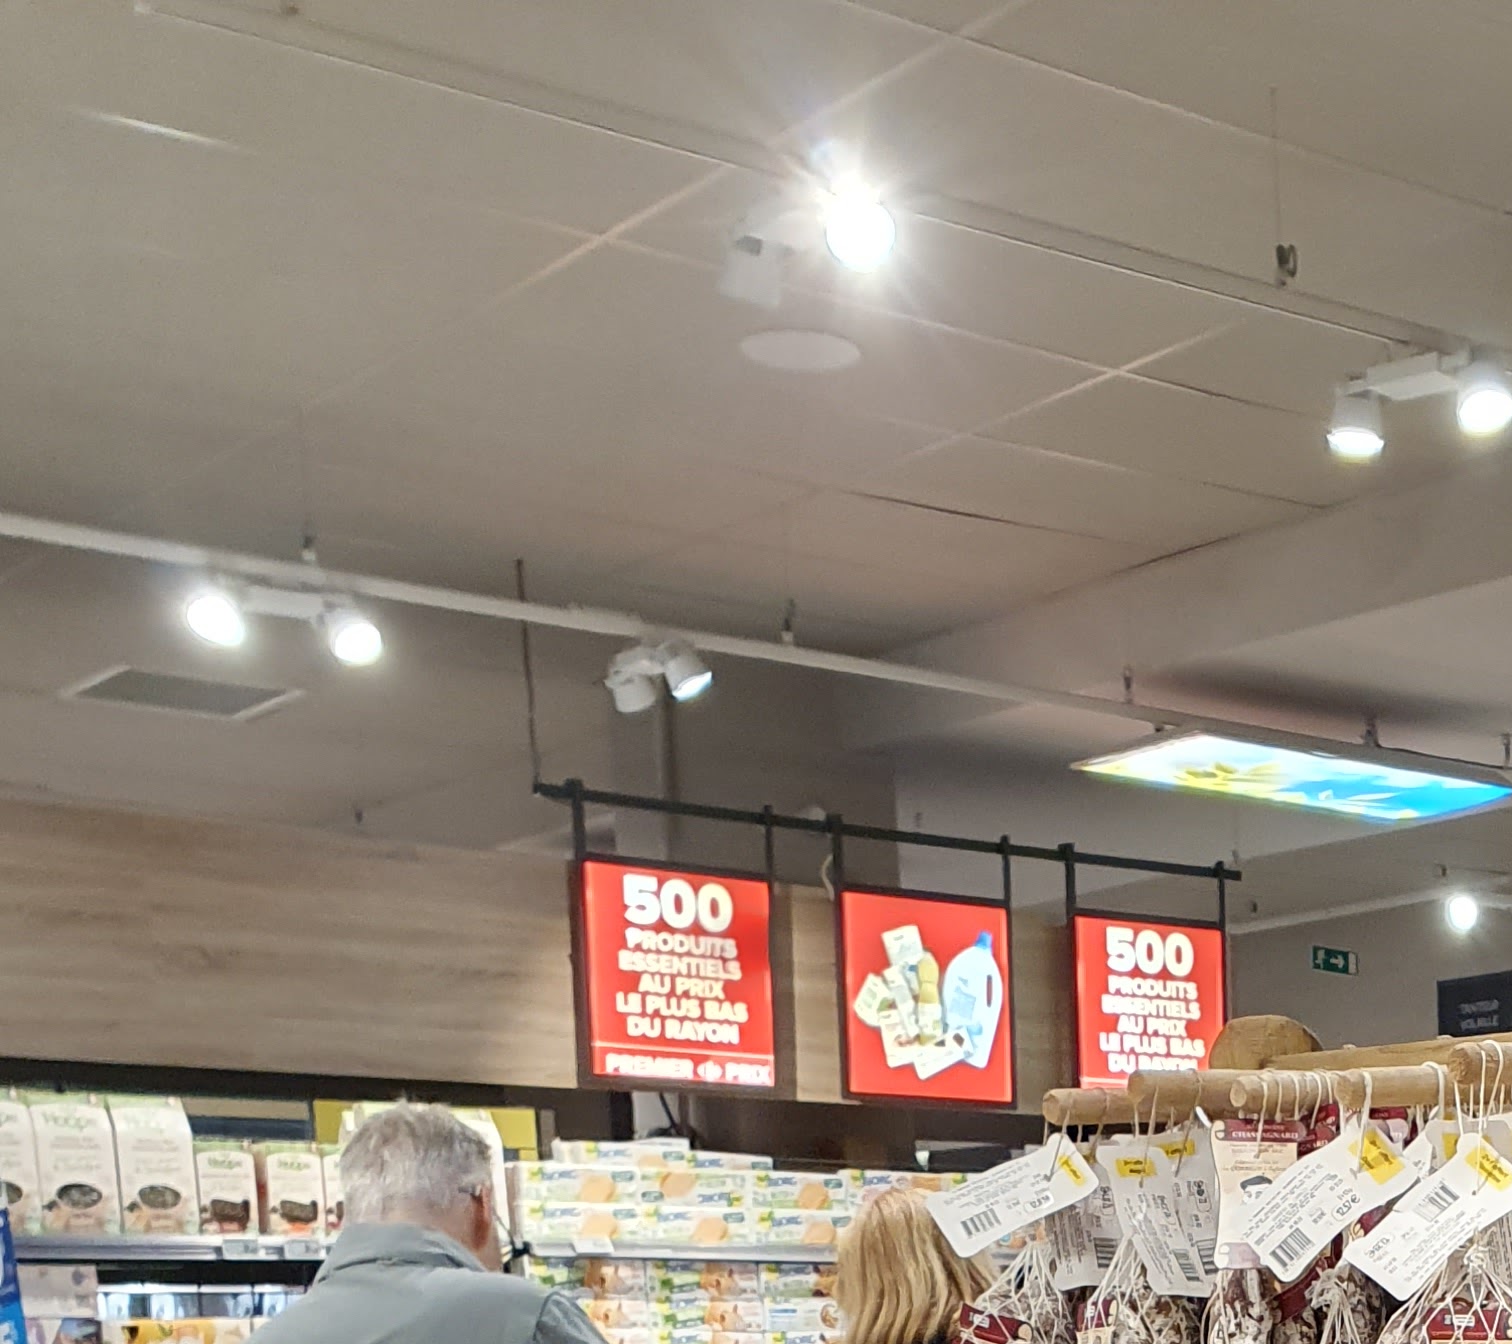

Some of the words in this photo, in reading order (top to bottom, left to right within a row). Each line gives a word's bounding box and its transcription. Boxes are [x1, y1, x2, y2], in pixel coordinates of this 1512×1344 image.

[622, 873, 733, 933] 500
[624, 927, 738, 959] PRODUITS
[1105, 926, 1194, 977] 500
[618, 949, 742, 981] ESSENTIELS
[638, 973, 672, 994] AU
[675, 976, 725, 999] PRIX
[1107, 974, 1198, 1000] PRODUITS
[616, 991, 642, 1014] LE
[645, 994, 701, 1018] PLUS
[704, 1000, 749, 1023] BAS
[1101, 994, 1201, 1021] ESSENTIELS
[626, 1016, 661, 1038] DU
[665, 1019, 740, 1044] RAYON
[1117, 1015, 1144, 1034] AU
[1146, 1017, 1188, 1037] PRIX
[1122, 1034, 1167, 1055] PLUS
[1169, 1038, 1206, 1057] BAS
[1107, 1052, 1136, 1073] DU
